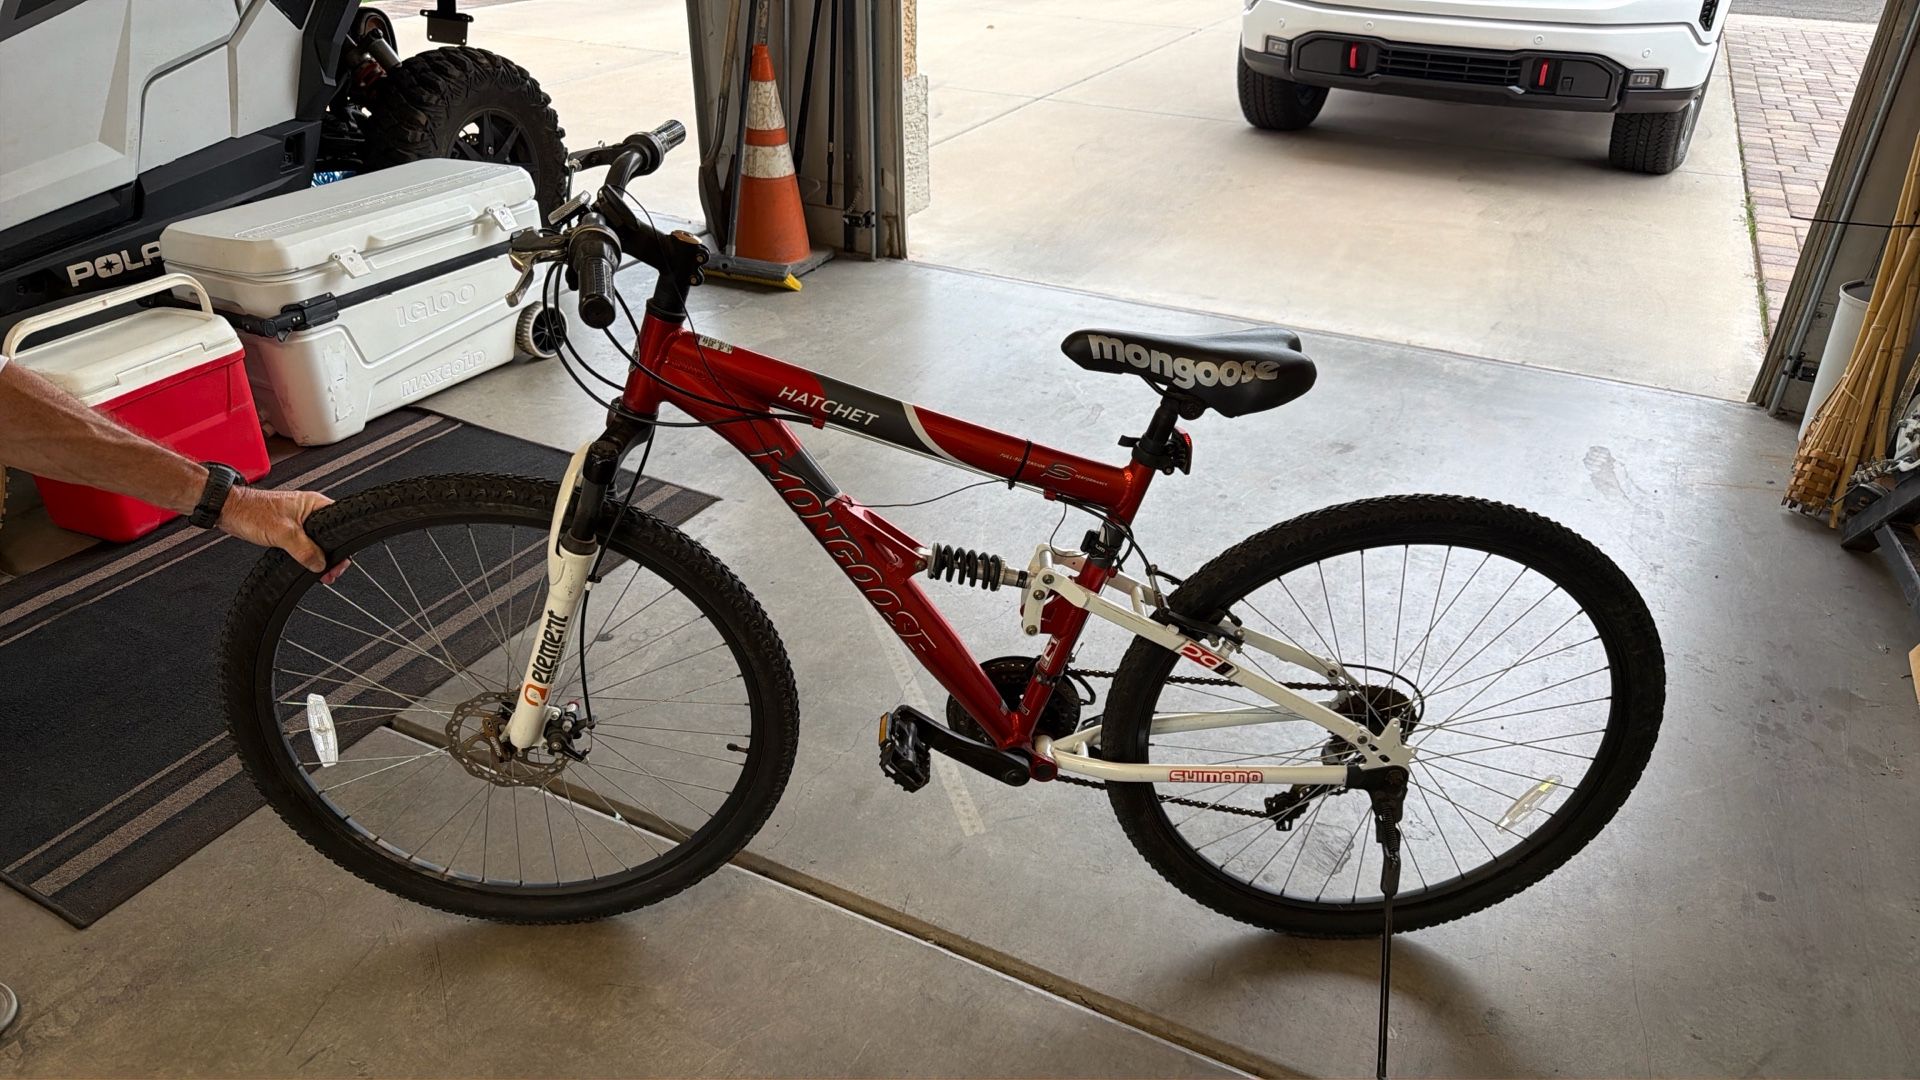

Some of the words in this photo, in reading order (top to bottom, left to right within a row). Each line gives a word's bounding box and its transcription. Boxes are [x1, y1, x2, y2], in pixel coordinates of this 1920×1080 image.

[395, 283, 476, 328] IGLOO
[402, 350, 486, 398] MAXCOLD
[1088, 334, 1281, 389] mongoose
[778, 386, 880, 425] HATCHET
[532, 609, 568, 684] element
[1170, 770, 1263, 783] SHIMANO
